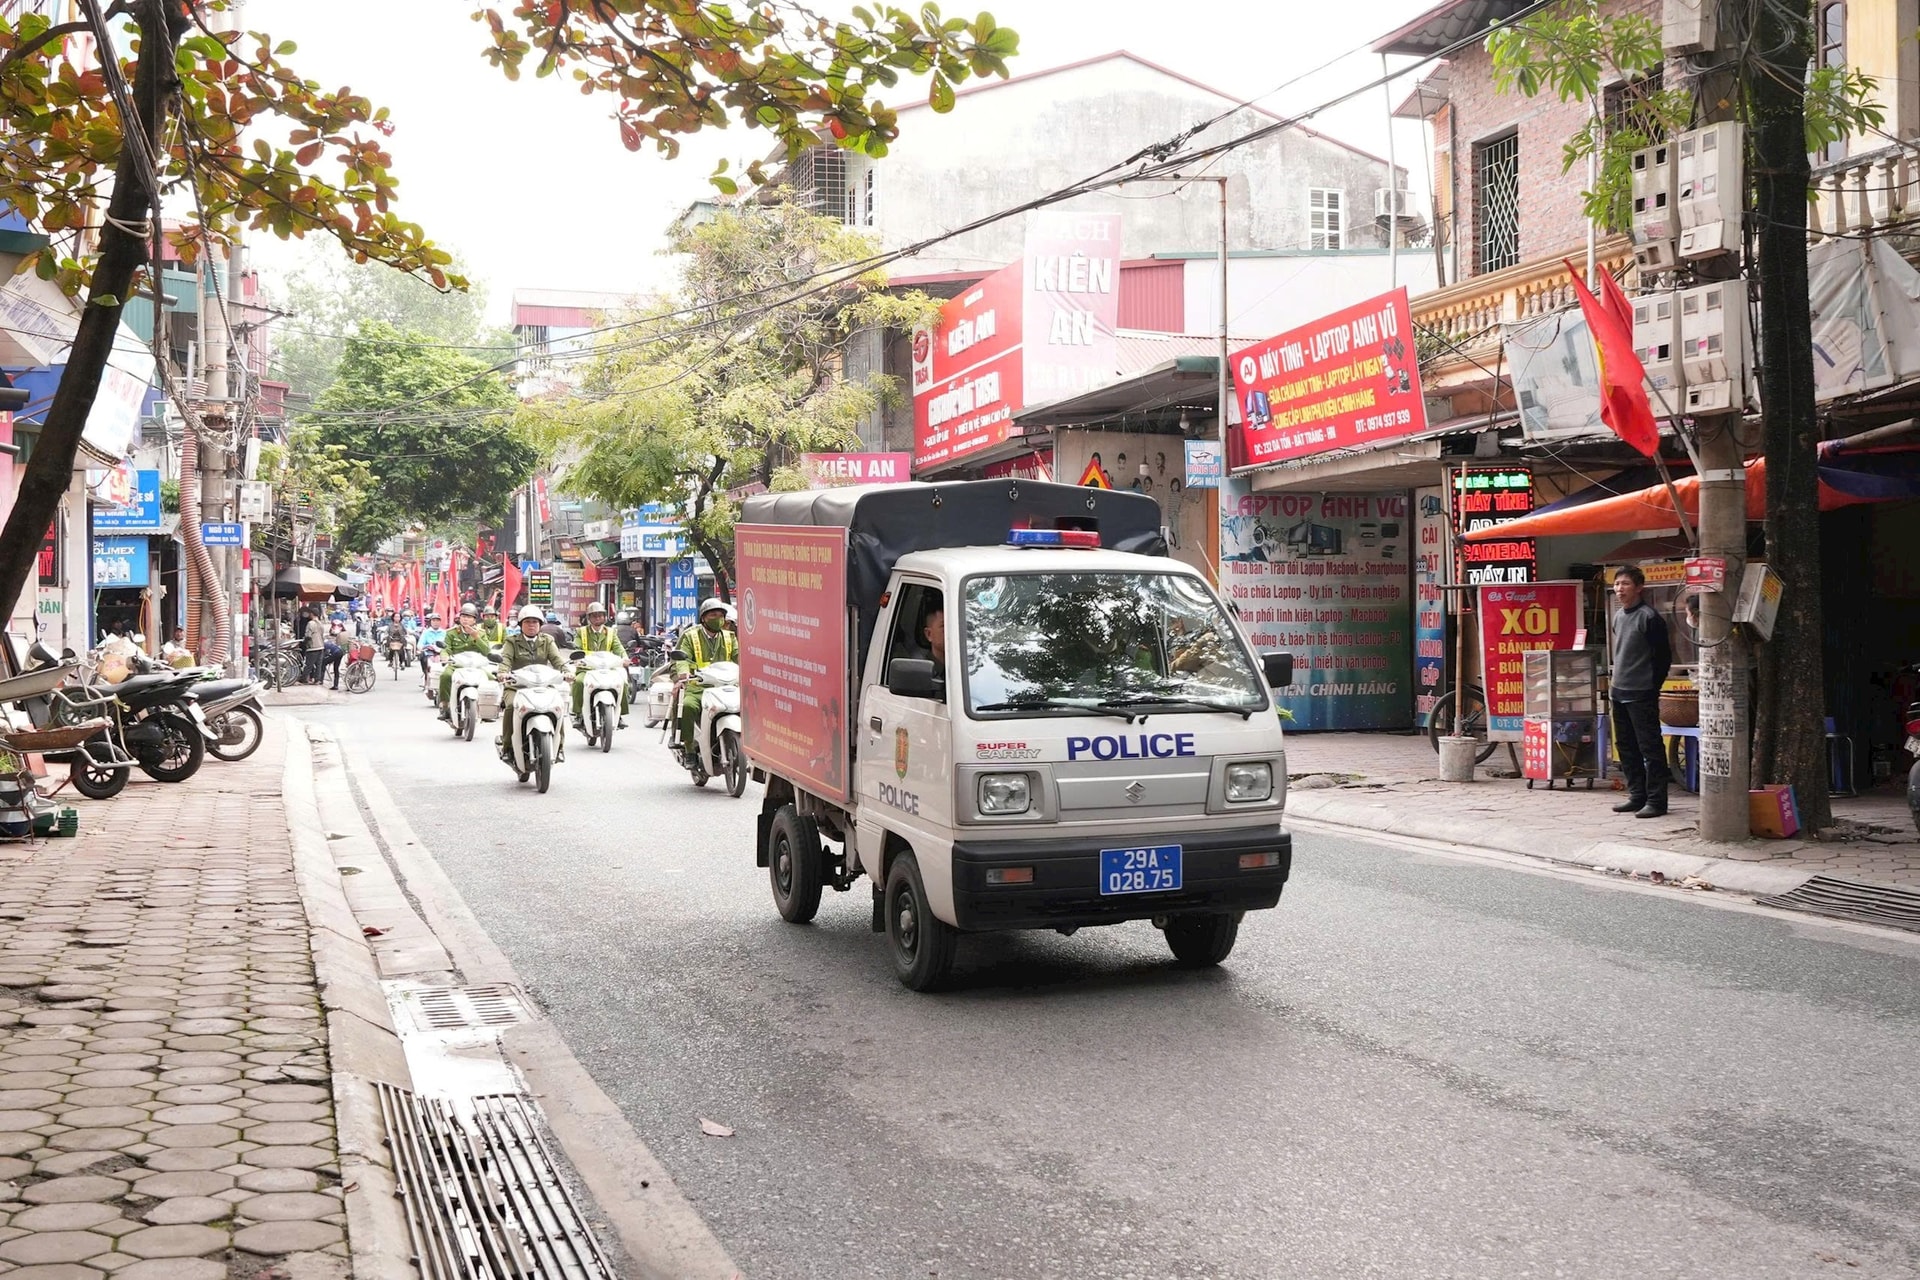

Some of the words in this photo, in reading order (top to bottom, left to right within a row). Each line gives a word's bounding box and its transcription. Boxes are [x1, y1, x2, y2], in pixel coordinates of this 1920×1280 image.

[1035, 251, 1111, 294] KIÊN
[975, 309, 996, 342] AN
[1049, 311, 1094, 345] AN
[1259, 347, 1279, 380] MÁY
[1279, 340, 1304, 373] TÍNH
[1309, 325, 1350, 363] LAPTOP
[1352, 314, 1379, 349] ANH
[1377, 302, 1398, 340] VŨ
[915, 370, 929, 386] TASA
[1367, 415, 1383, 432] 0974
[1384, 411, 1396, 428] 937
[1397, 409, 1411, 425] 939
[818, 457, 862, 477] KIÊN
[868, 459, 895, 477] AN
[1227, 495, 1312, 518] LAPTOP
[1321, 496, 1369, 519] ANH
[1458, 490, 1492, 512] MÁY
[1494, 489, 1528, 511] TÍNH
[93, 547, 135, 555] OLIMEX
[1463, 542, 1531, 561] CAMERA
[1232, 563, 1247, 575] Mua
[1270, 562, 1285, 575] Trao
[1300, 562, 1324, 577] Laptop
[1326, 562, 1359, 576] Macbook
[1365, 562, 1407, 577] Smartphone
[1467, 564, 1504, 584] MÁY
[1508, 566, 1527, 583] IN
[1646, 565, 1677, 573] BÁNH
[1232, 584, 1248, 599] Sửa
[1250, 585, 1271, 599] chữa
[1273, 585, 1301, 601] Laptop
[1309, 585, 1322, 601] Uy
[1341, 584, 1371, 601] Chuyên
[1372, 585, 1400, 601] nghiệp
[1256, 607, 1274, 624] phối
[1276, 608, 1293, 622] linh
[1295, 608, 1313, 625] kiện
[1315, 608, 1343, 624] Laptop
[1352, 608, 1389, 622] Macbook
[1500, 603, 1560, 635] XÔI
[1251, 631, 1277, 648] dưỡng
[1279, 632, 1287, 646] &
[1317, 631, 1328, 648] hệ
[1330, 631, 1353, 648] thống
[1355, 633, 1382, 648] Laptop
[1389, 632, 1401, 645] PC
[1498, 640, 1531, 654] BÁNH
[1314, 655, 1333, 669] thiết
[1499, 660, 1524, 674] BÚN
[1421, 661, 1439, 686] CẤP
[1497, 680, 1524, 695] BÁNH
[1497, 699, 1524, 714] BÁNH
[976, 748, 1041, 759] CARRY
[977, 742, 1027, 750] SUPER
[1067, 732, 1196, 761] POLICE
[878, 781, 919, 815] POLICE
[1124, 850, 1159, 869] 29A
[1109, 870, 1174, 891] 028.75
